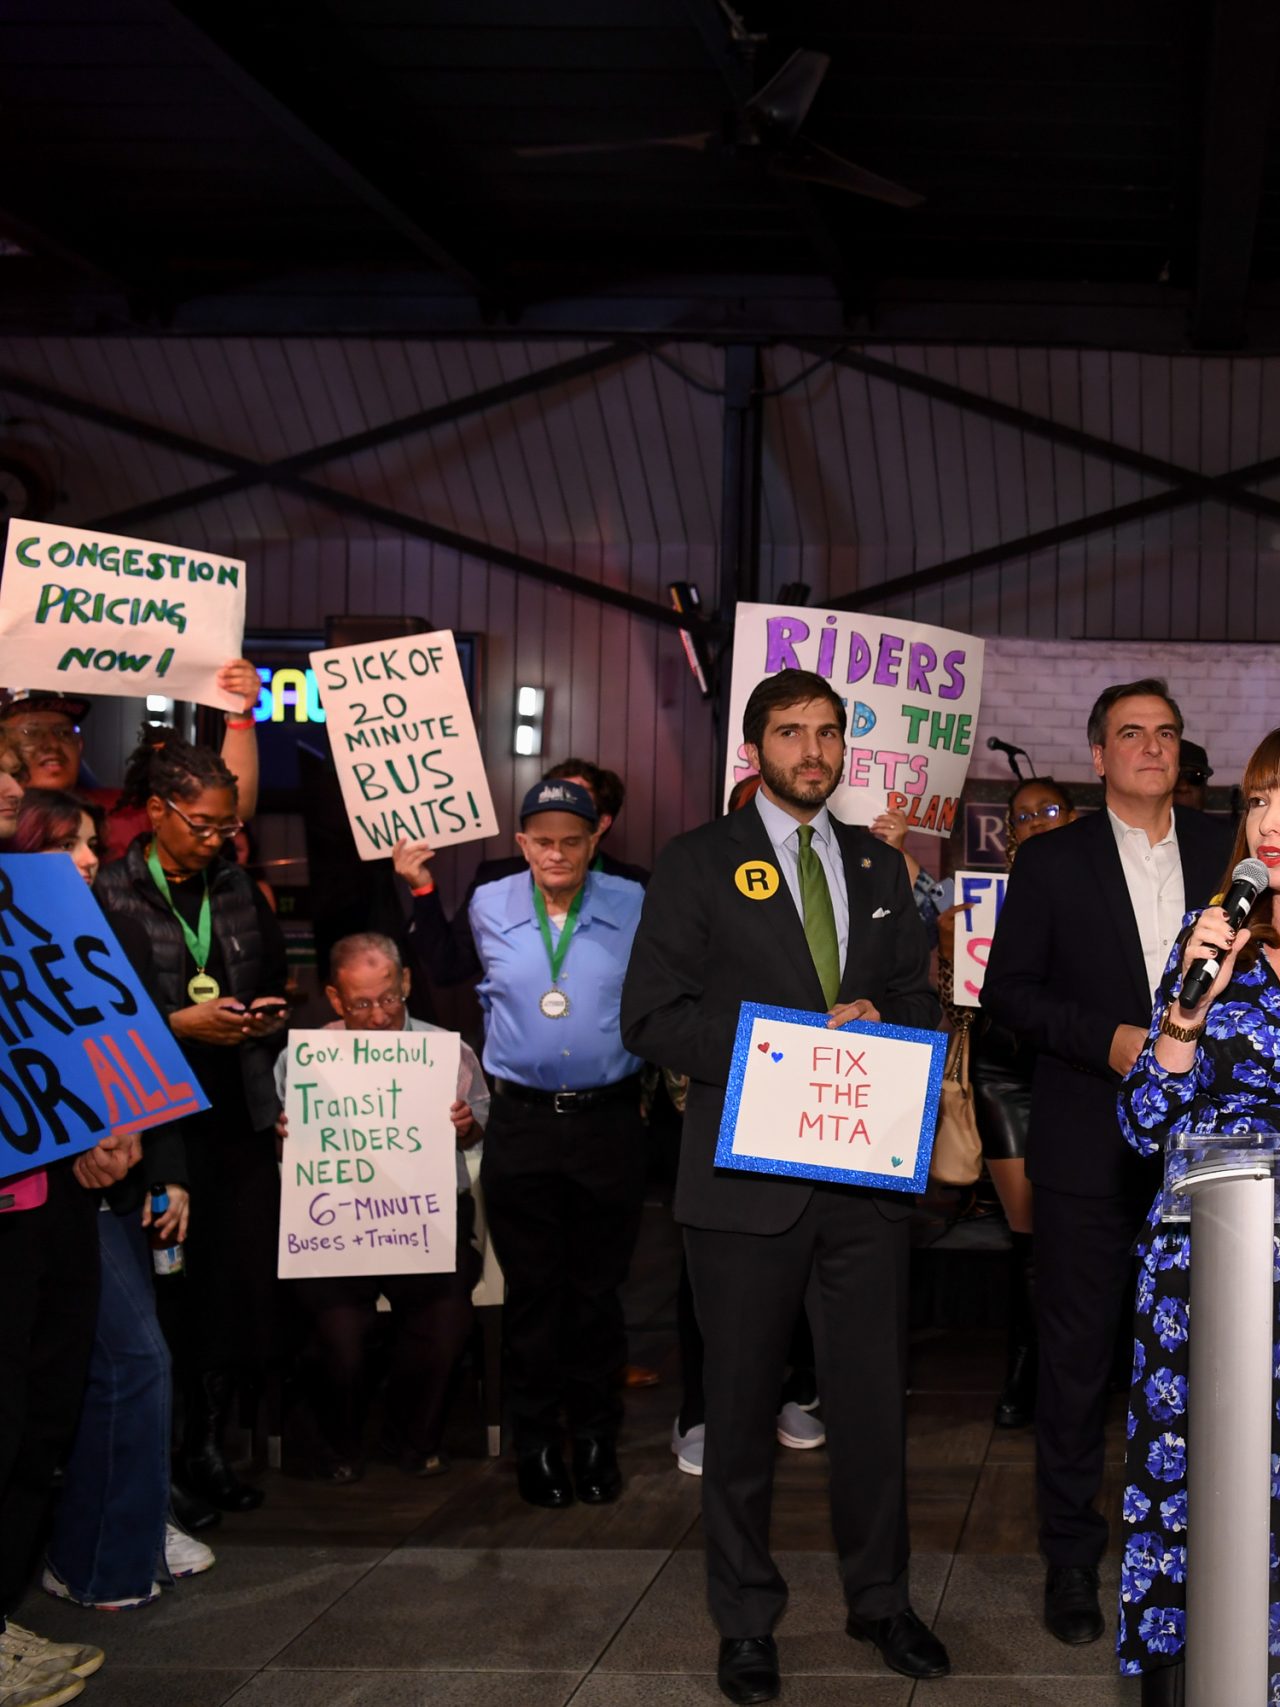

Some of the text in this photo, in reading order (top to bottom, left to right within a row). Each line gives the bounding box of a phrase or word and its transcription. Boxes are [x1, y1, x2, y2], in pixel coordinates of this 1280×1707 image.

[16, 537, 239, 588] CONGESTION
[35, 584, 187, 634] PRICING
[57, 648, 175, 678] NOW!
[324, 647, 443, 690] SICK OF
[349, 693, 407, 725] 20
[345, 715, 458, 752] MINUTE
[902, 704, 972, 755] THE
[352, 749, 454, 801] BUS
[355, 791, 481, 850] WAITS!
[886, 791, 960, 832] PLAN
[745, 868, 769, 891] R
[296, 1038, 434, 1067] Gov. Hochul,
[813, 1046, 868, 1077] FIX
[83, 1029, 195, 1125] ALL
[294, 1079, 402, 1125] Transit
[809, 1083, 871, 1108] THE
[321, 1126, 422, 1153] RIDERS
[798, 1111, 871, 1145] MTA
[296, 1158, 375, 1186] NEED
[309, 1193, 440, 1226] 6-MINUTE
[288, 1233, 346, 1254] Buses
